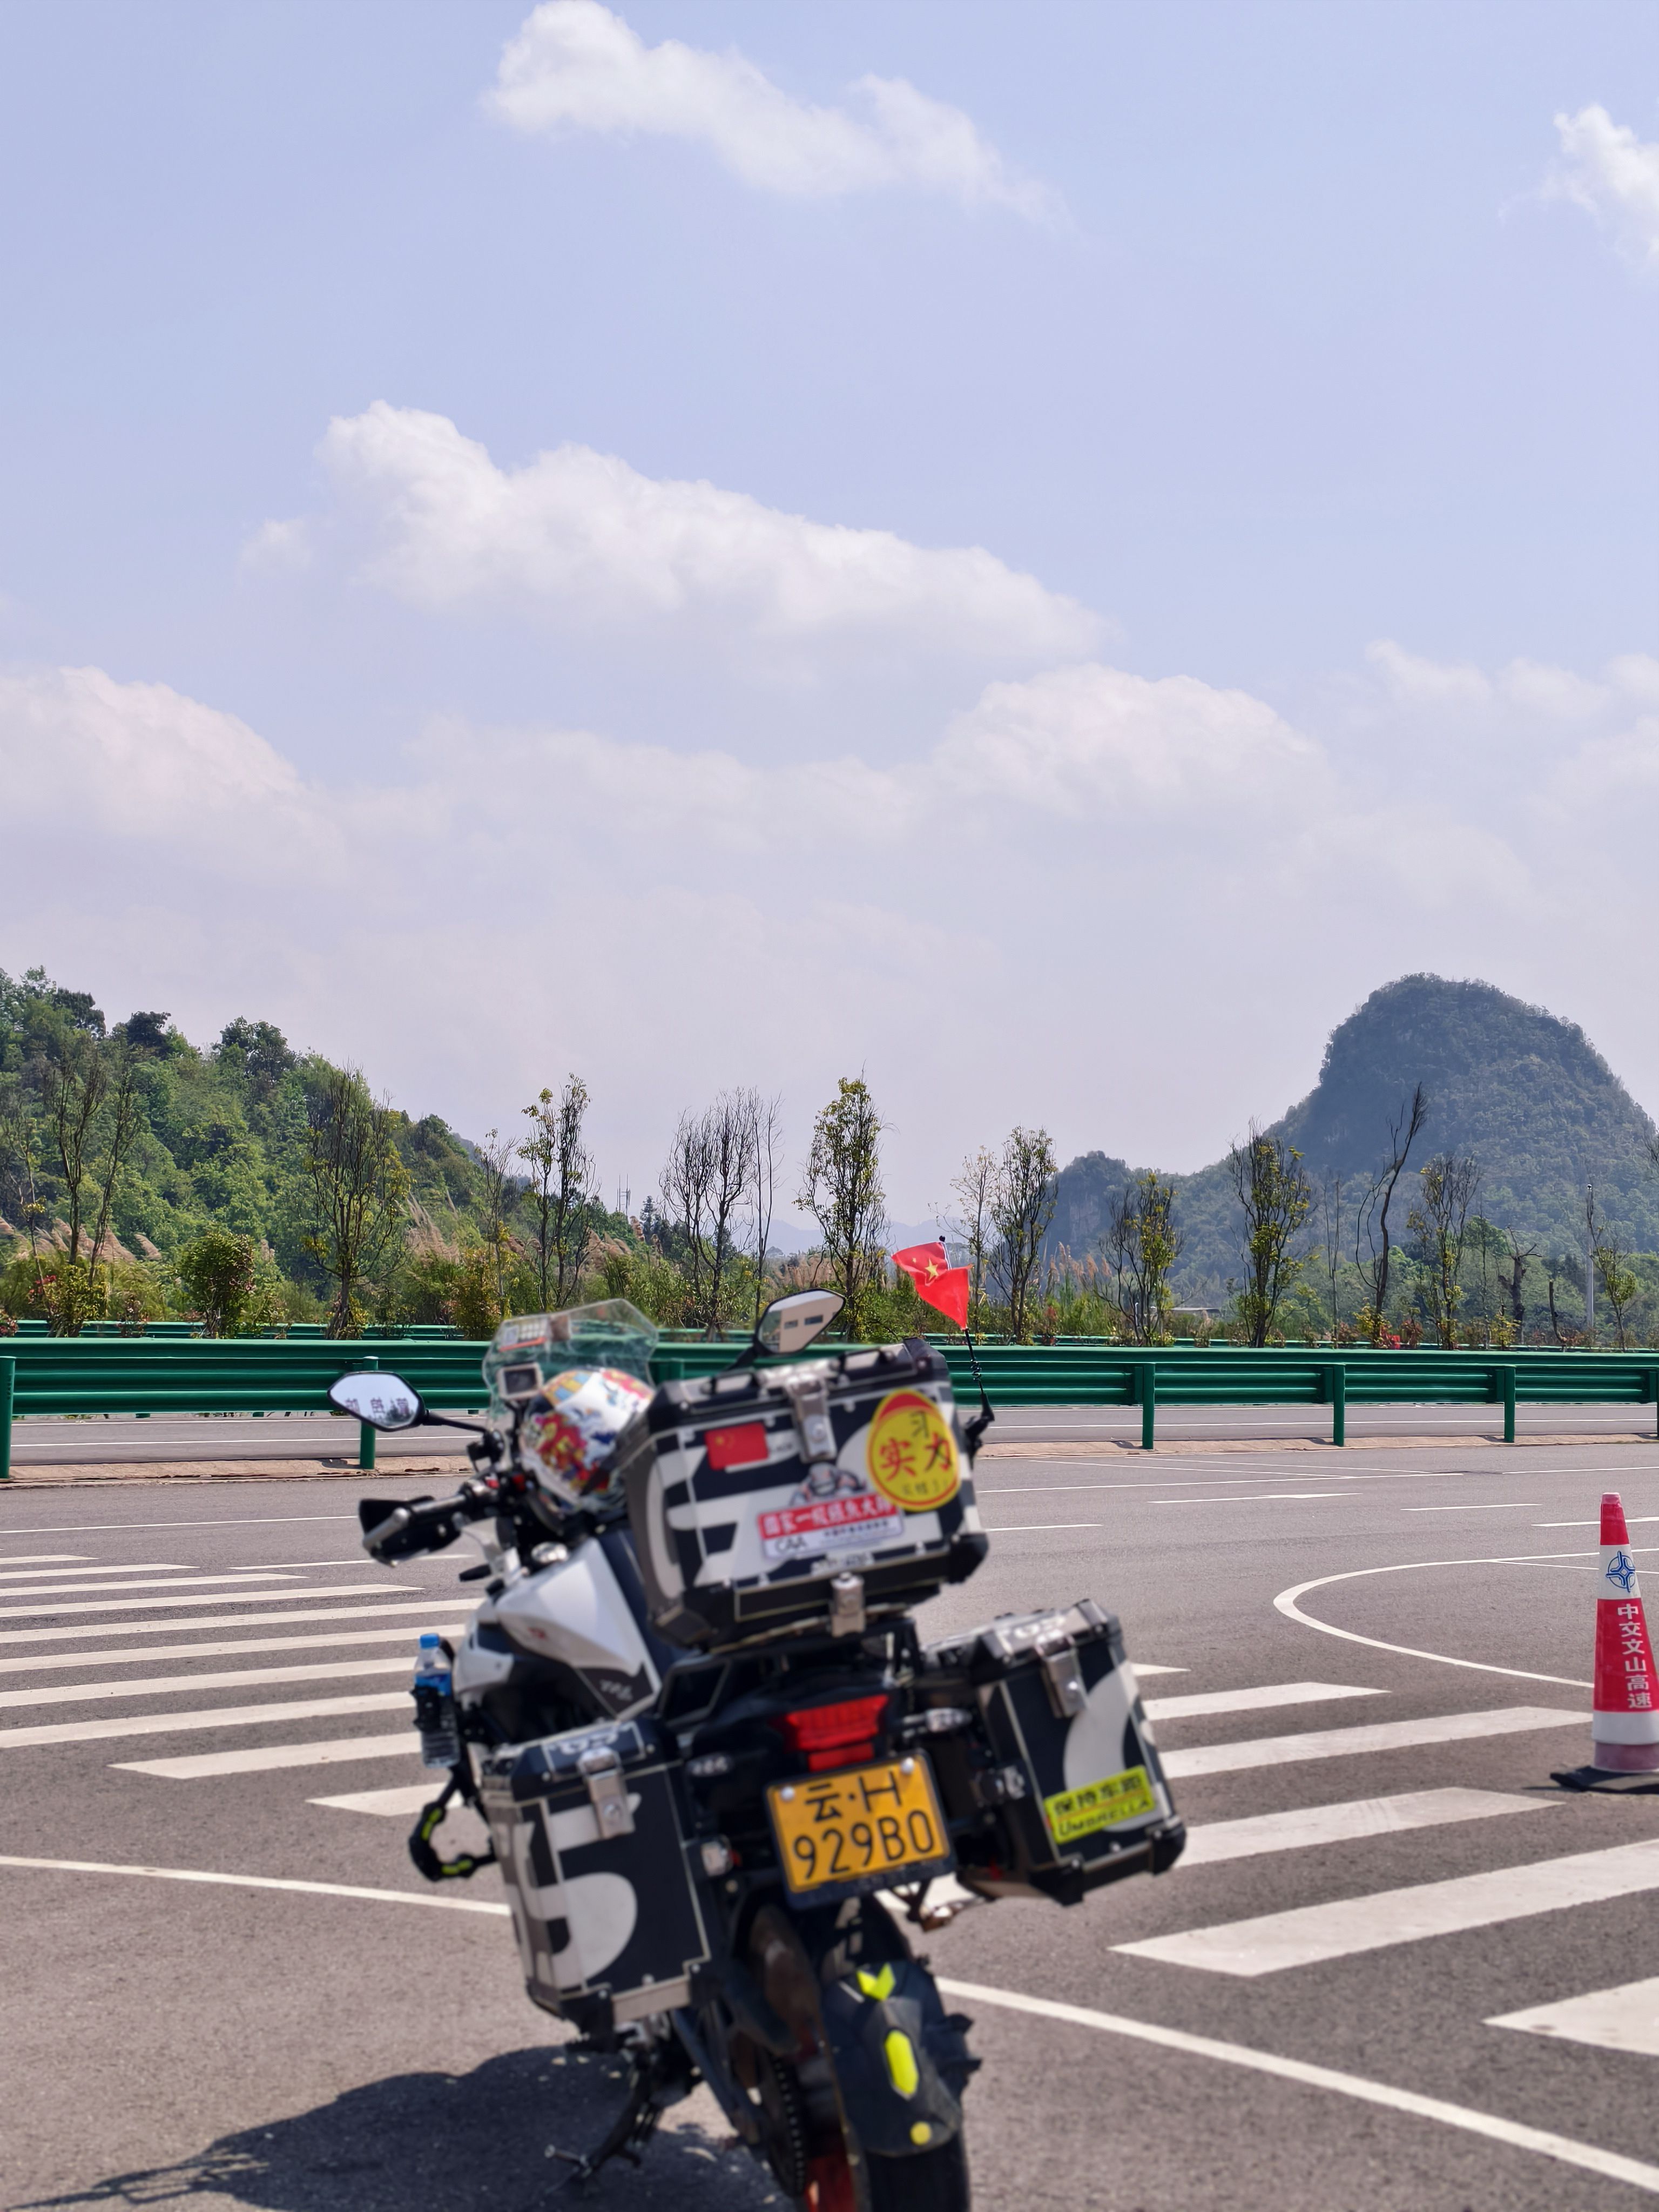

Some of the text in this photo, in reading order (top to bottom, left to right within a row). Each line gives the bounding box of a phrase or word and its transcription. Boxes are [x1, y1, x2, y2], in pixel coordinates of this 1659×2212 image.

[1617, 1603, 1653, 1709] 中交文山高速
